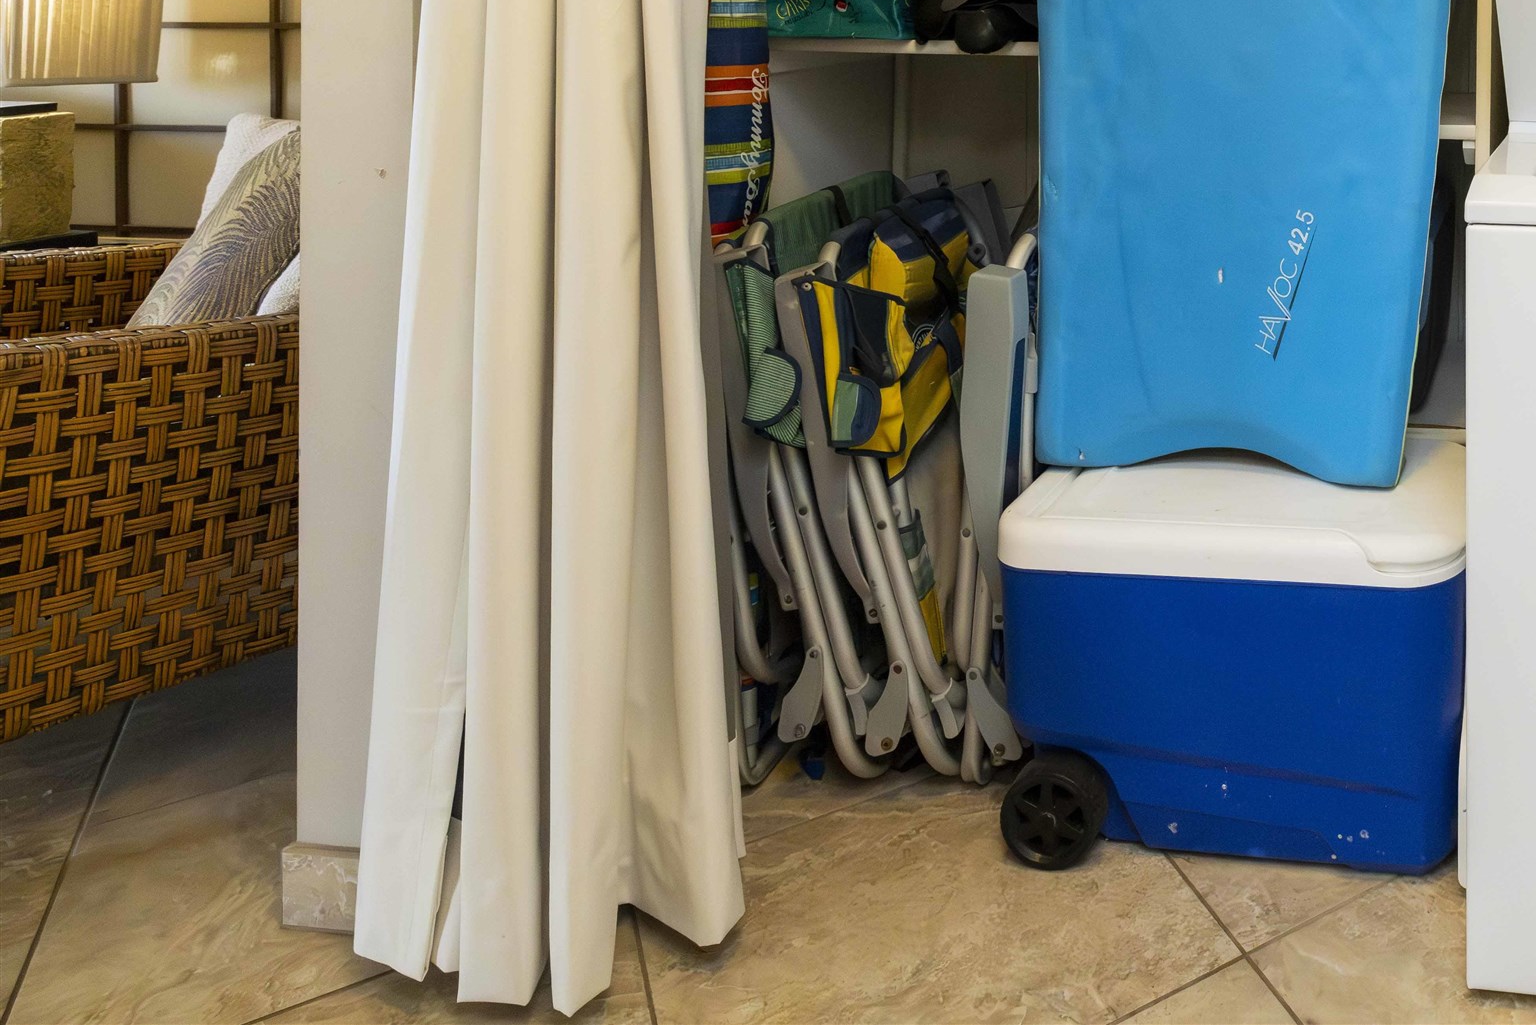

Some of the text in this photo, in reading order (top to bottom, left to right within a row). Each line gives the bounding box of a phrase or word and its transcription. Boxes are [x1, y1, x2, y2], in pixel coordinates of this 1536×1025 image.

[741, 68, 769, 175] Tommy
[1254, 209, 1314, 355] HAVOC 42.5
